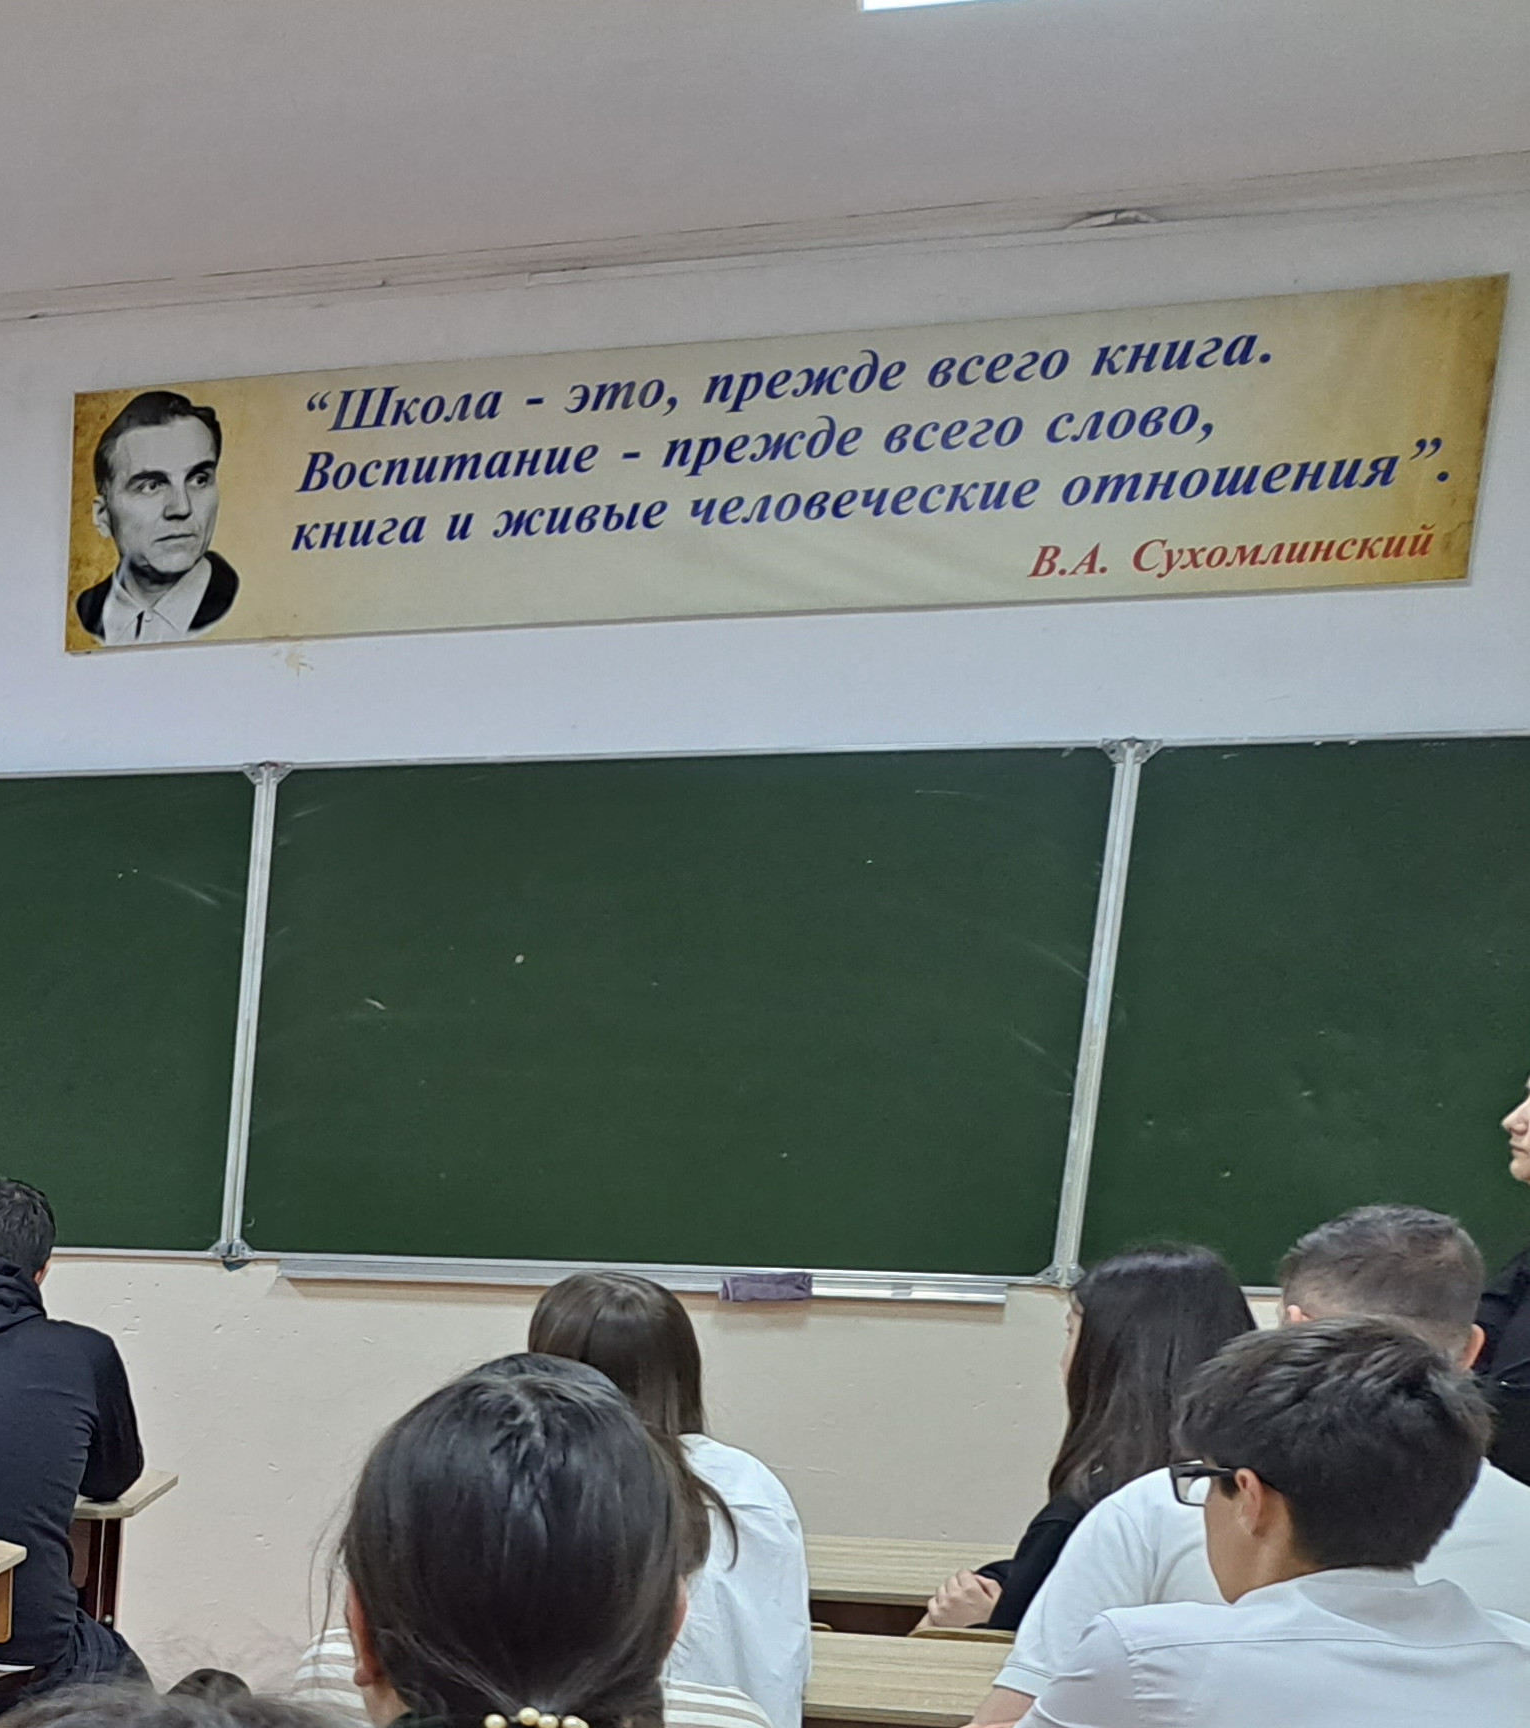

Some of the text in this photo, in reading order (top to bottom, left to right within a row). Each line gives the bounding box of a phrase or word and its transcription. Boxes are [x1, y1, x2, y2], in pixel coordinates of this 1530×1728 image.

[306, 385, 503, 432] “Школа
[563, 376, 679, 417] это,
[702, 349, 907, 413] прежде
[926, 347, 1069, 389] всего
[1090, 333, 1272, 377] книга.
[295, 442, 599, 493] Воспитание
[661, 415, 863, 477] прежде
[884, 414, 1024, 455] всего
[1046, 403, 1214, 444] слово,
[291, 513, 427, 551] книга
[446, 512, 474, 542] и
[492, 499, 668, 538] живые
[690, 477, 1040, 527] человеческие
[1027, 523, 1437, 579] В.А. Сухомлинский
